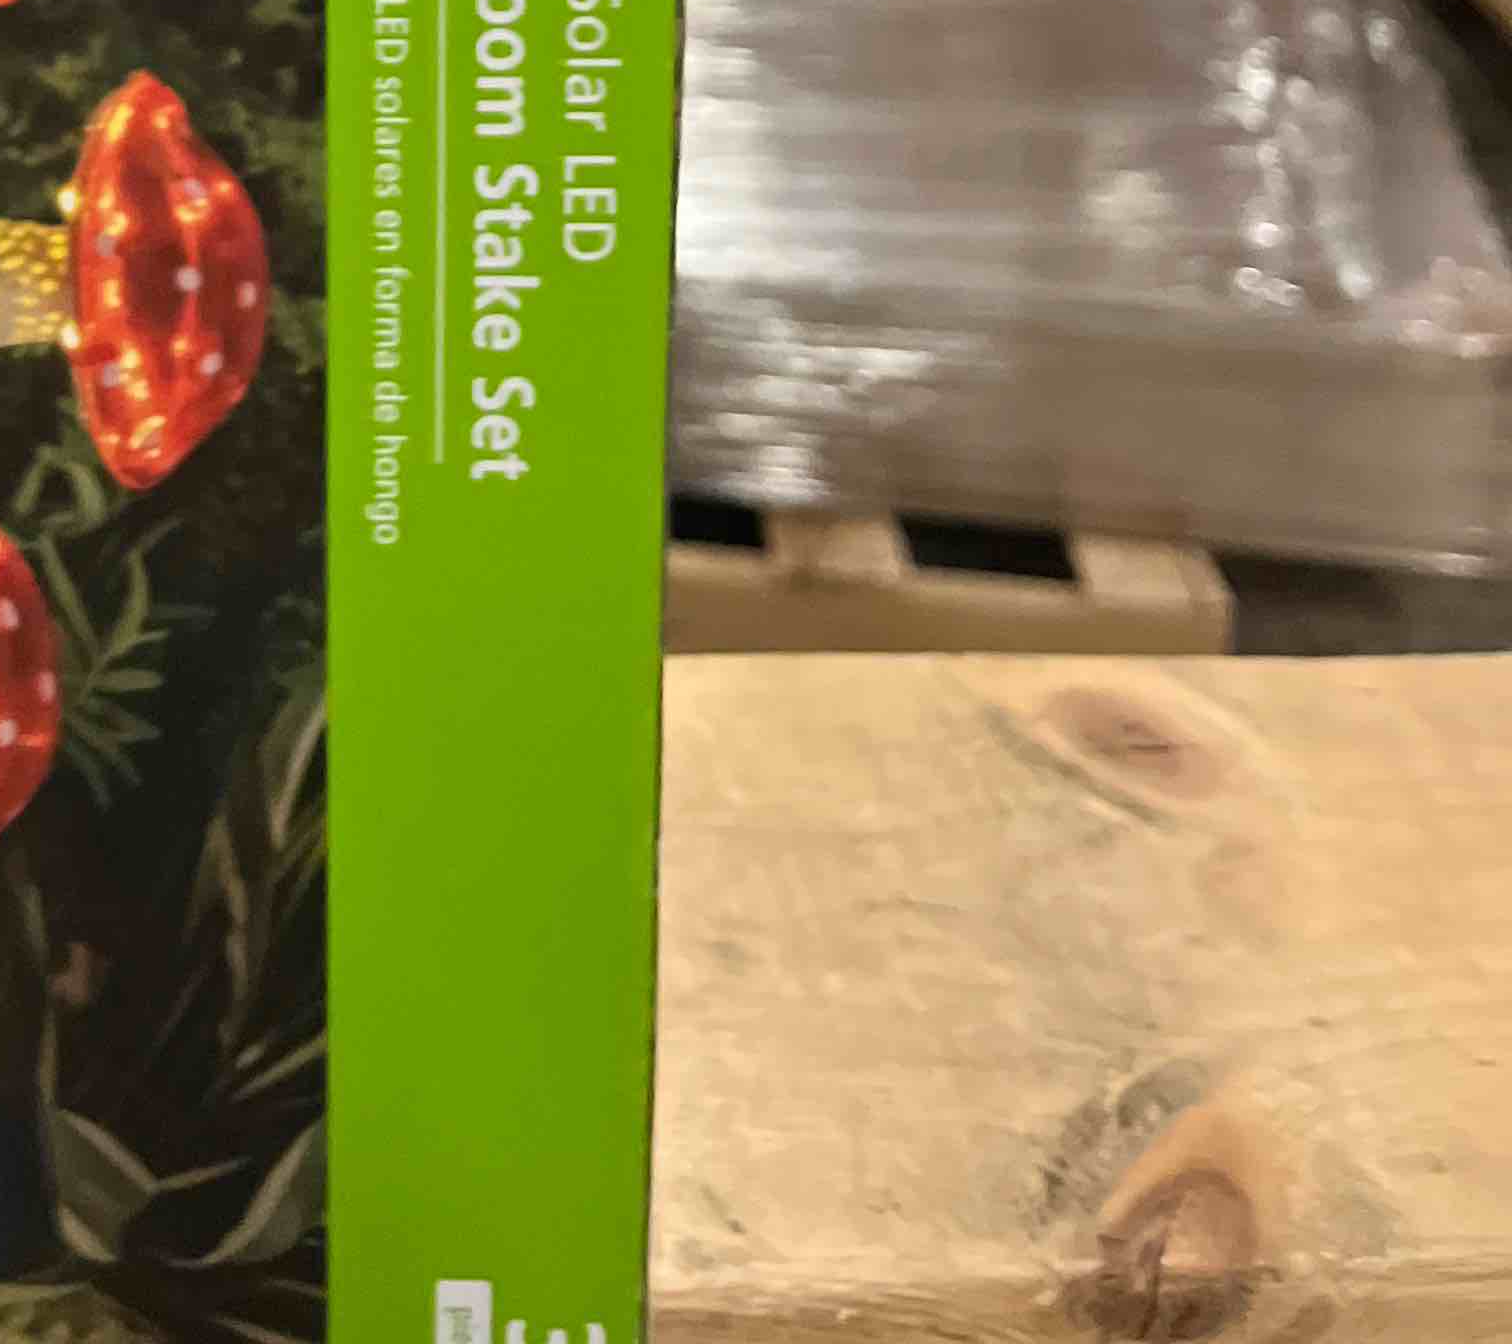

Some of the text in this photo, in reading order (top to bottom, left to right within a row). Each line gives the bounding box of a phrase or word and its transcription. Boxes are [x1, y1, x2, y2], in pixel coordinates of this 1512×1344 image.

[376, 77, 408, 198] solares
[375, 210, 402, 252] en
[472, 164, 540, 351] Stake
[563, 156, 616, 261] LED
[375, 266, 408, 369] forma
[375, 381, 408, 422] de
[471, 377, 535, 480] Set
[365, 435, 408, 544] hongo
